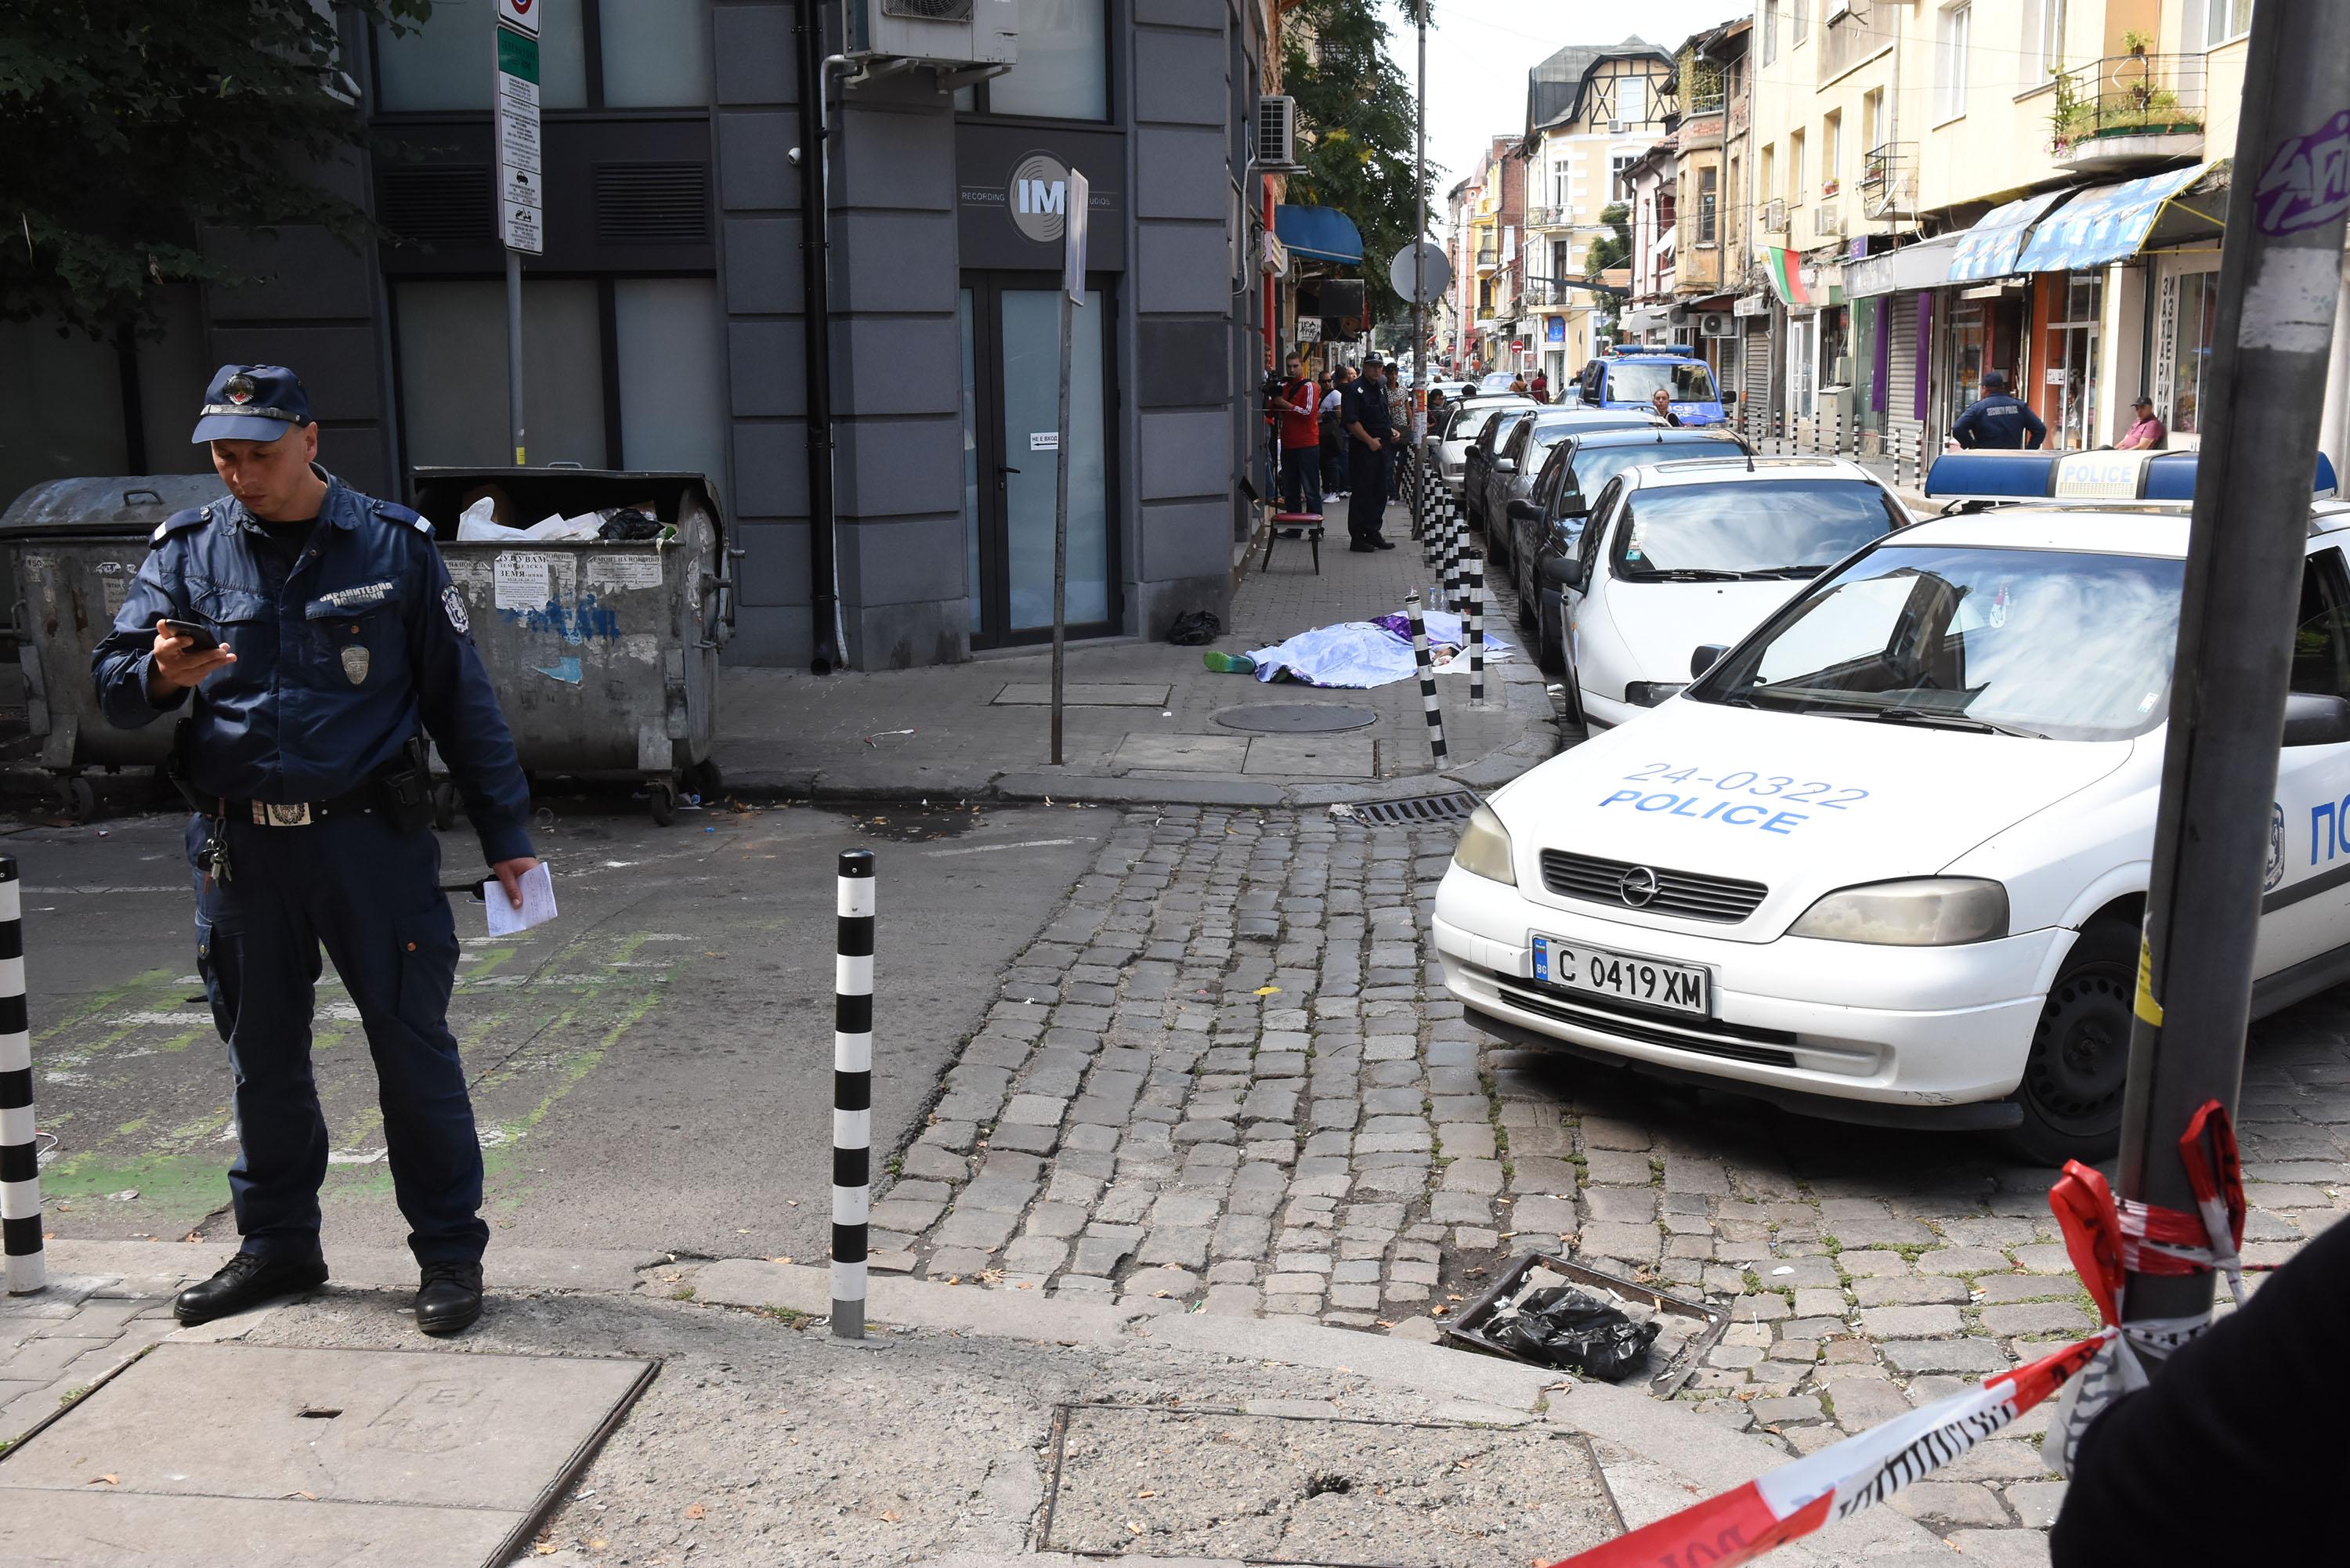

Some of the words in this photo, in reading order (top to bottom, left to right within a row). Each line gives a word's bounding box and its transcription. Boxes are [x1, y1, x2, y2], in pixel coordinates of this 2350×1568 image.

[962, 192, 1005, 201] RECORDING
[1090, 197, 1110, 206] UDIOS
[1019, 179, 1065, 215] IM
[2162, 276, 2175, 426] ИЗДЕЛИЯ
[2063, 464, 2133, 483] POLICE
[1622, 763, 1870, 810] 24-0322
[1598, 789, 1810, 835] POLICE
[1536, 963, 1547, 975] BG
[1559, 949, 1576, 982] C
[1590, 956, 1657, 999] 0419
[1662, 968, 1701, 1008] XM
